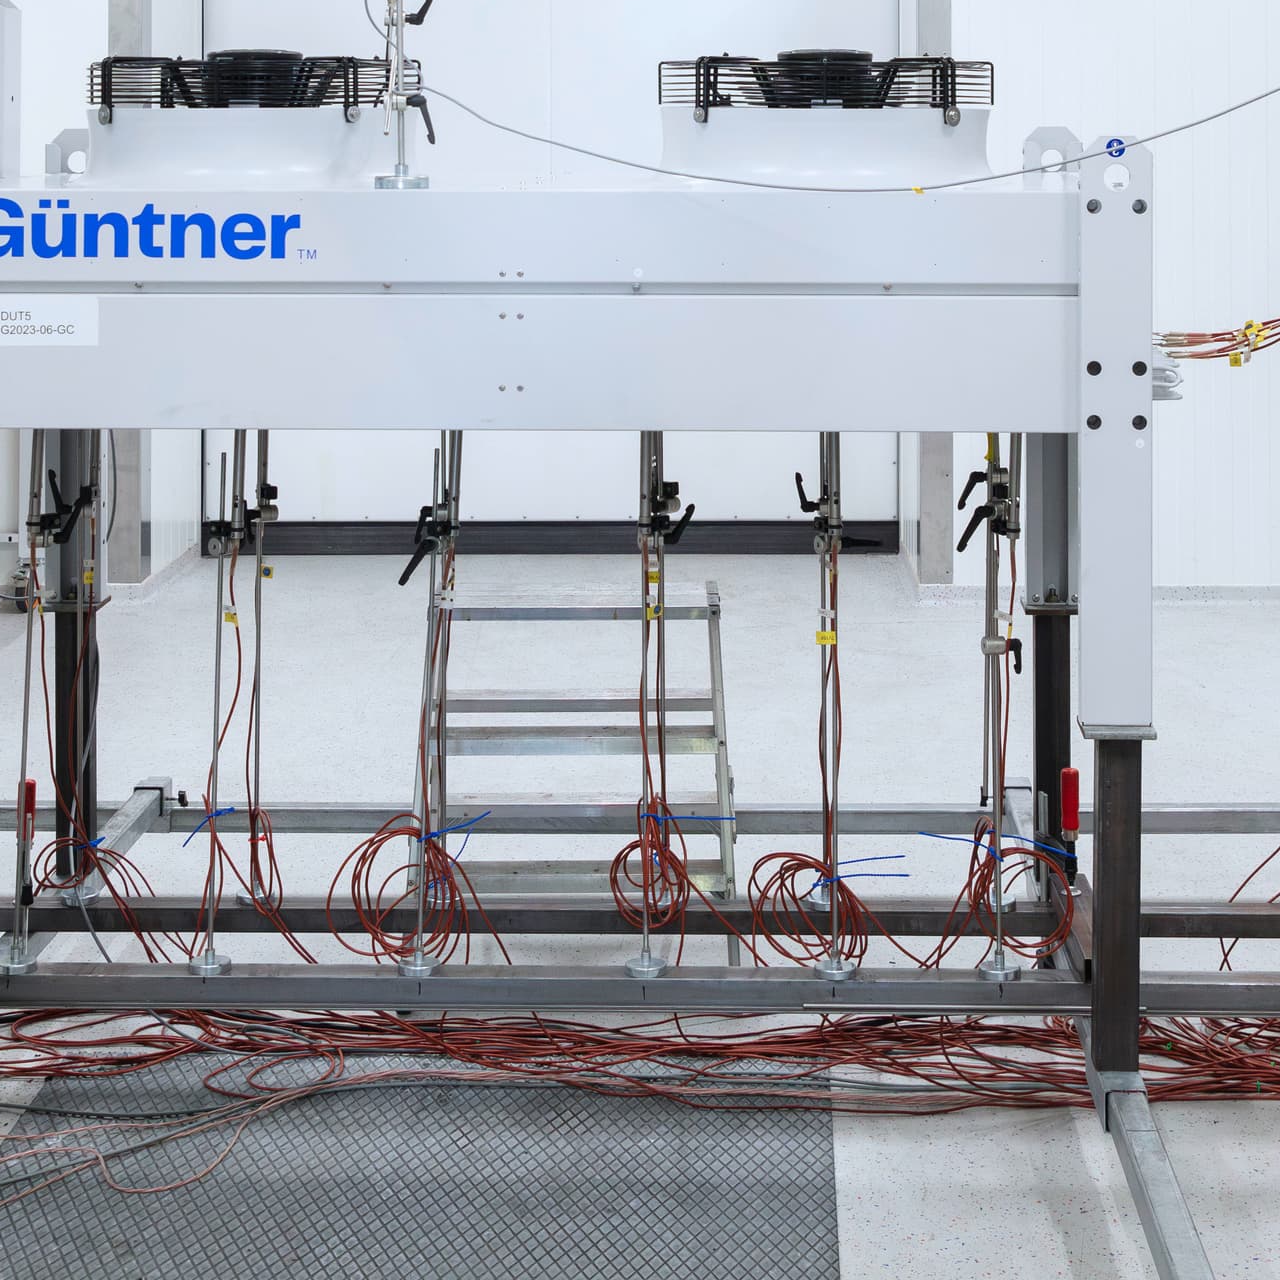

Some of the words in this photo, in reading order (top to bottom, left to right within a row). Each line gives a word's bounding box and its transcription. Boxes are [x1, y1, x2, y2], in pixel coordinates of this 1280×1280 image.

[297, 249, 318, 260] TM
[0, 311, 32, 321] DUT5
[0, 324, 75, 336] G2023-06-GC
